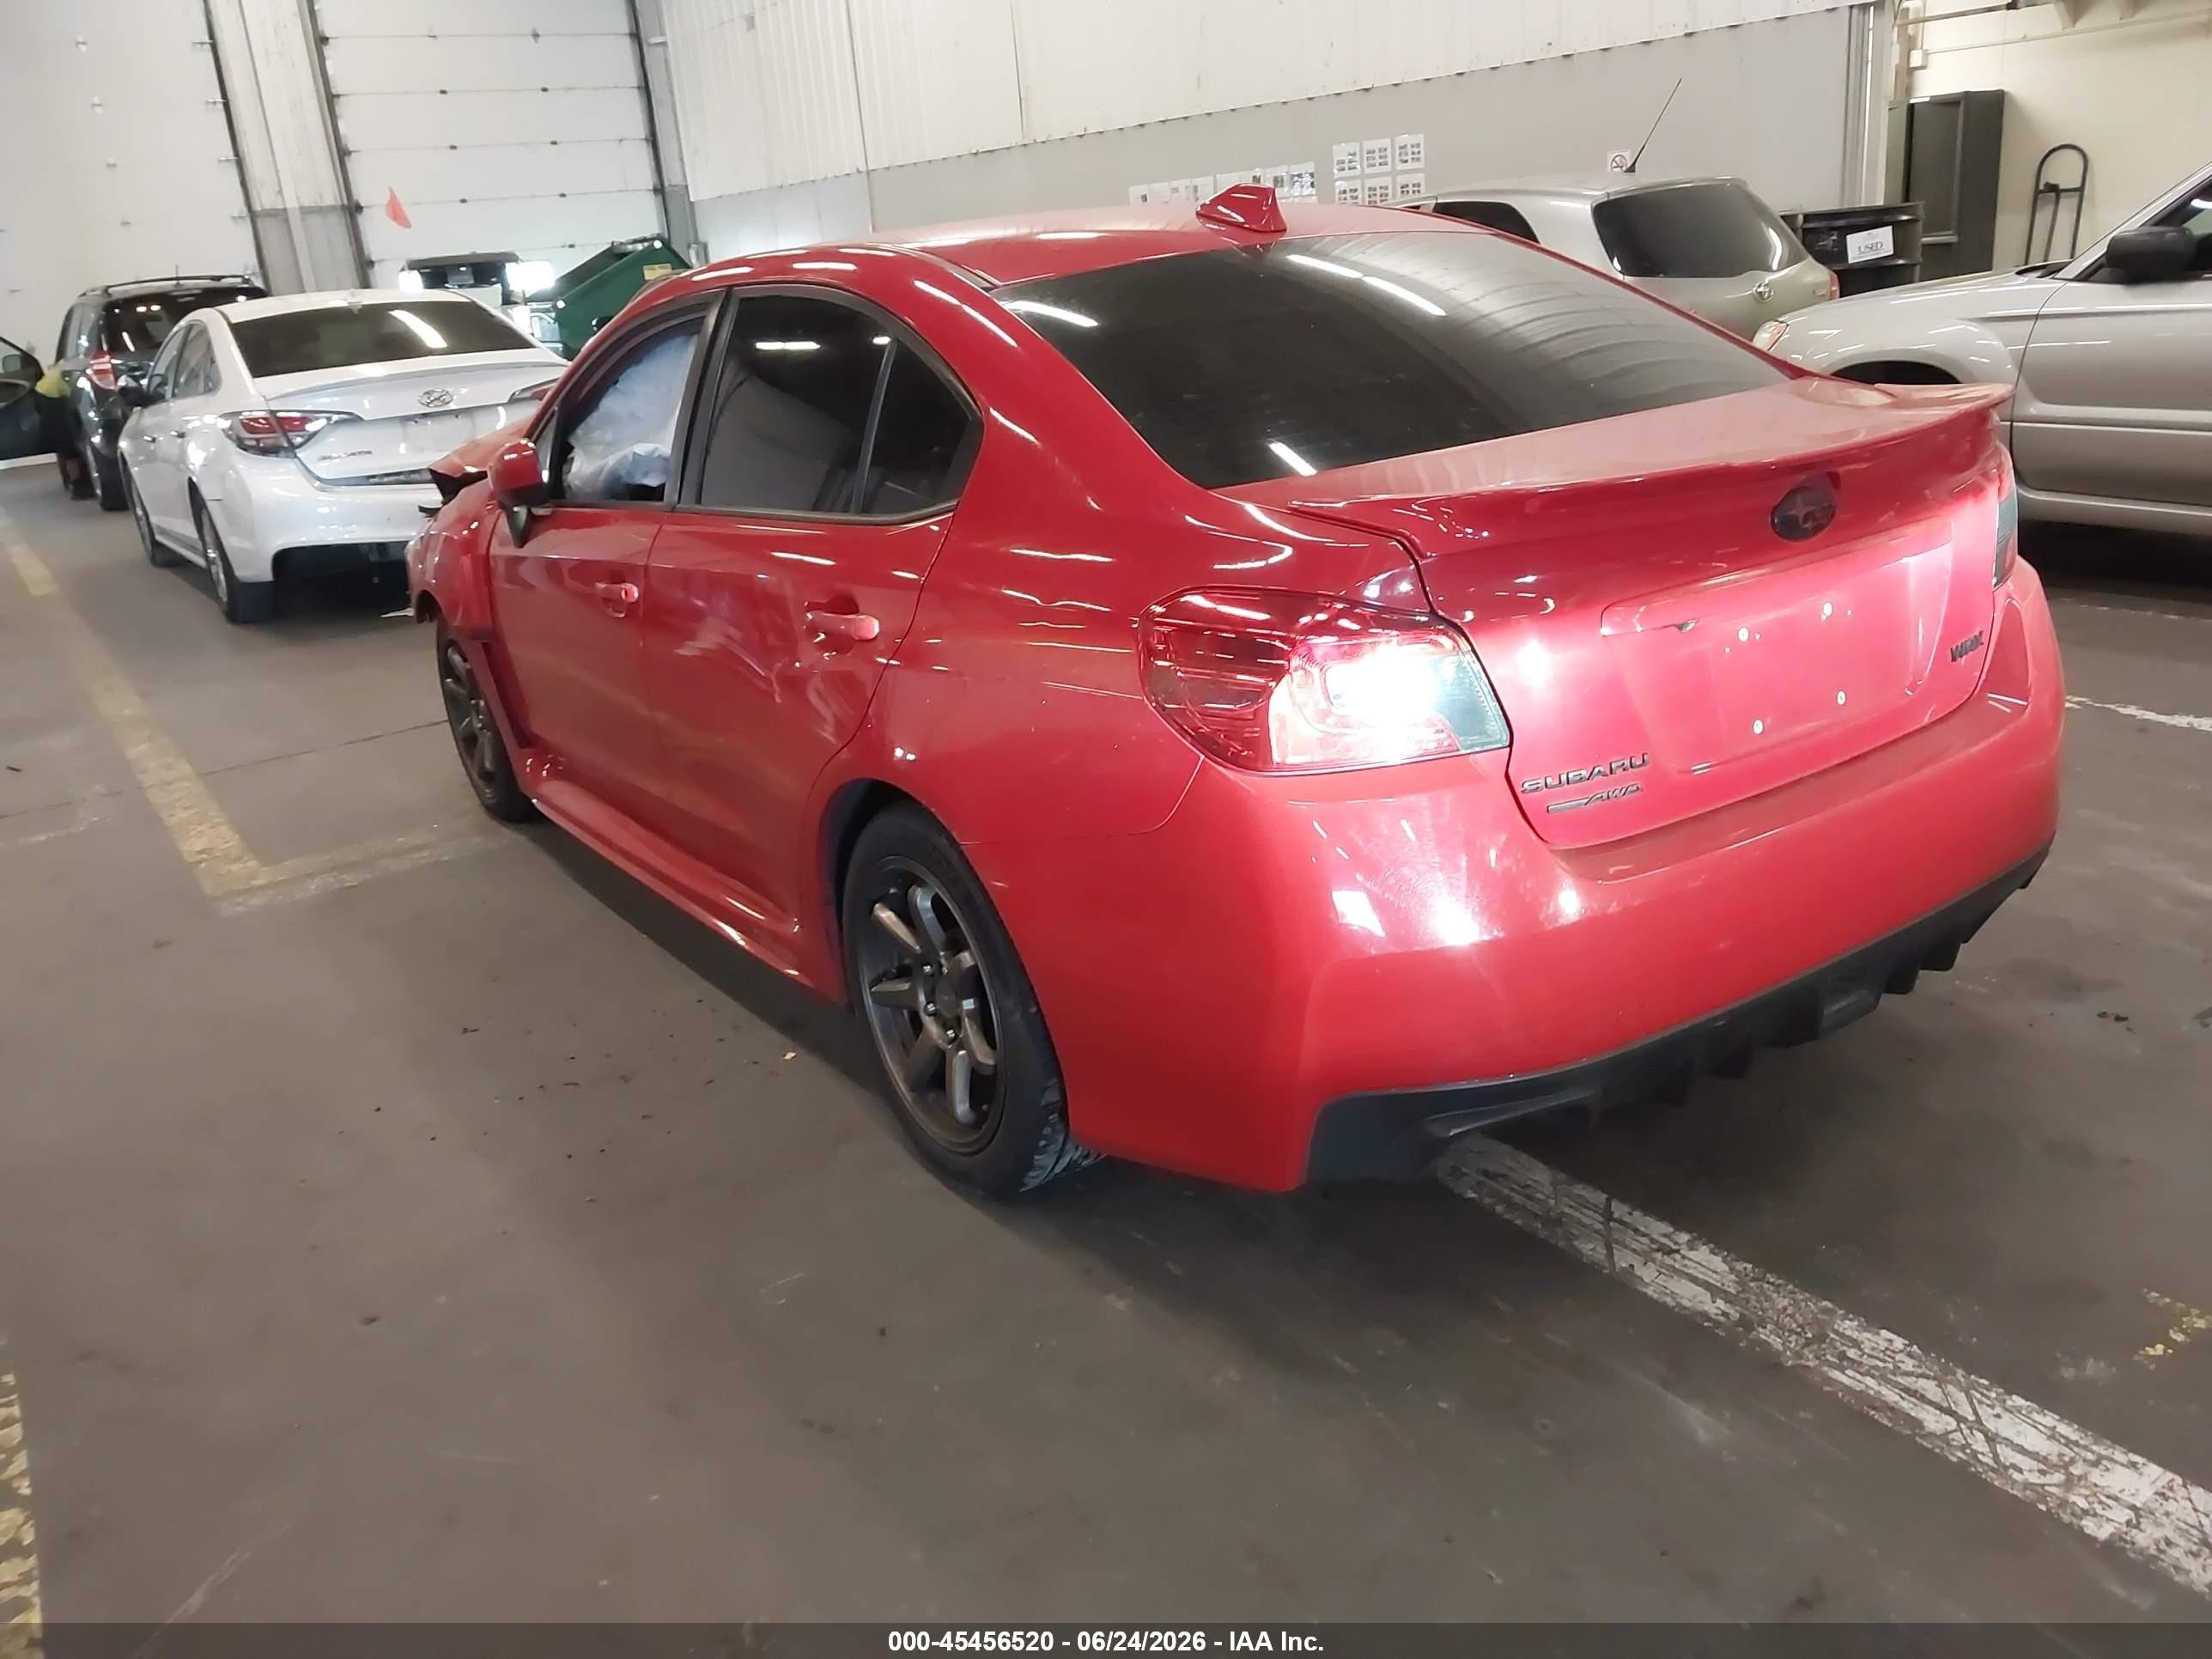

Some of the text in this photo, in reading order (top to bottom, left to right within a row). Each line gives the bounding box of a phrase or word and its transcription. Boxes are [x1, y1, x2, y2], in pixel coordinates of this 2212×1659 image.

[1857, 241, 1883, 255] USED
[1950, 630, 1984, 662] WRX
[1521, 752, 1650, 793] SUBARU
